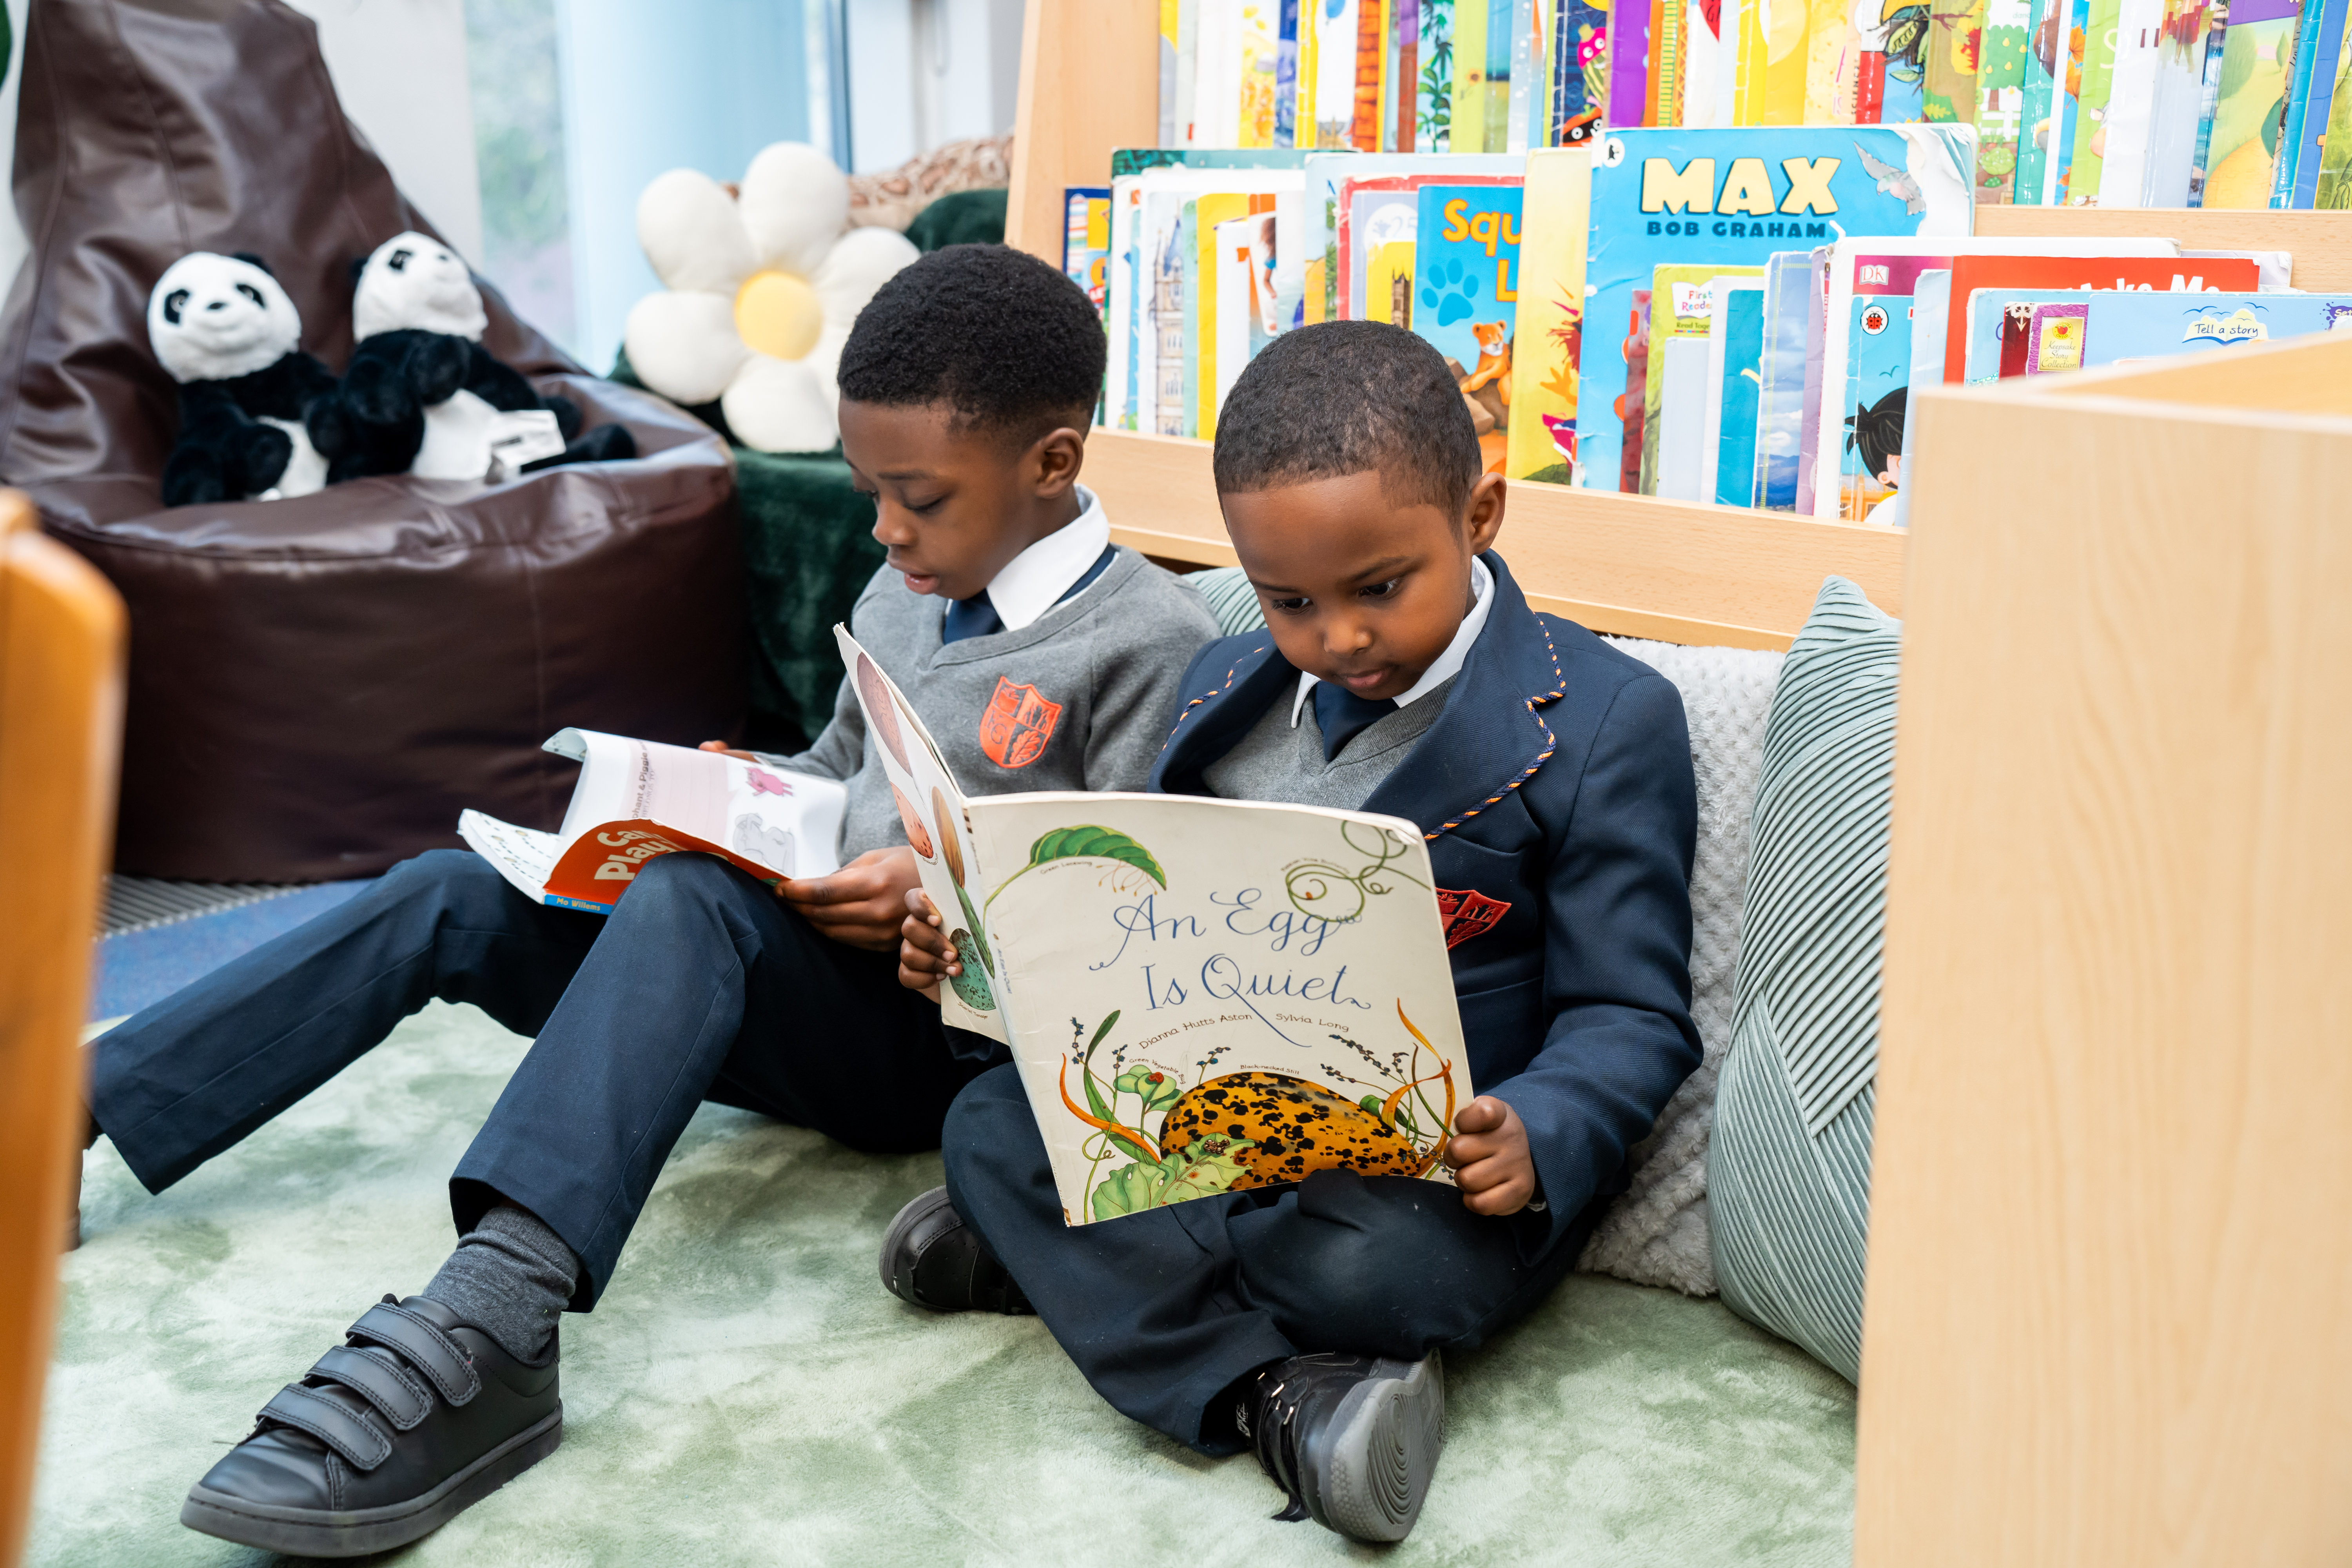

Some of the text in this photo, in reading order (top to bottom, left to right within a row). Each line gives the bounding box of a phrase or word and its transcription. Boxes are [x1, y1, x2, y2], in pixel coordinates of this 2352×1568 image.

[1639, 156, 1842, 218] MAX
[1442, 198, 1522, 257] Squ
[1647, 221, 1826, 238] BOB GRAHAM
[1862, 267, 1885, 281] DK
[1689, 290, 1712, 299] First
[2195, 324, 2214, 334] Tell
[2230, 325, 2258, 338] story
[2044, 341, 2076, 351] Keepsake
[2042, 358, 2076, 368] Collection
[2050, 350, 2068, 361] Story
[639, 752, 649, 782] Piggie
[557, 898, 601, 911] Mo Willems
[1089, 888, 1362, 970] An Egg
[1140, 953, 1371, 1047] Is Quiet
[1138, 1013, 1253, 1049] Dianna Hutts Aston
[1276, 1013, 1350, 1033] Sylvia Long
[1152, 1059, 1179, 1074] Vegetable
